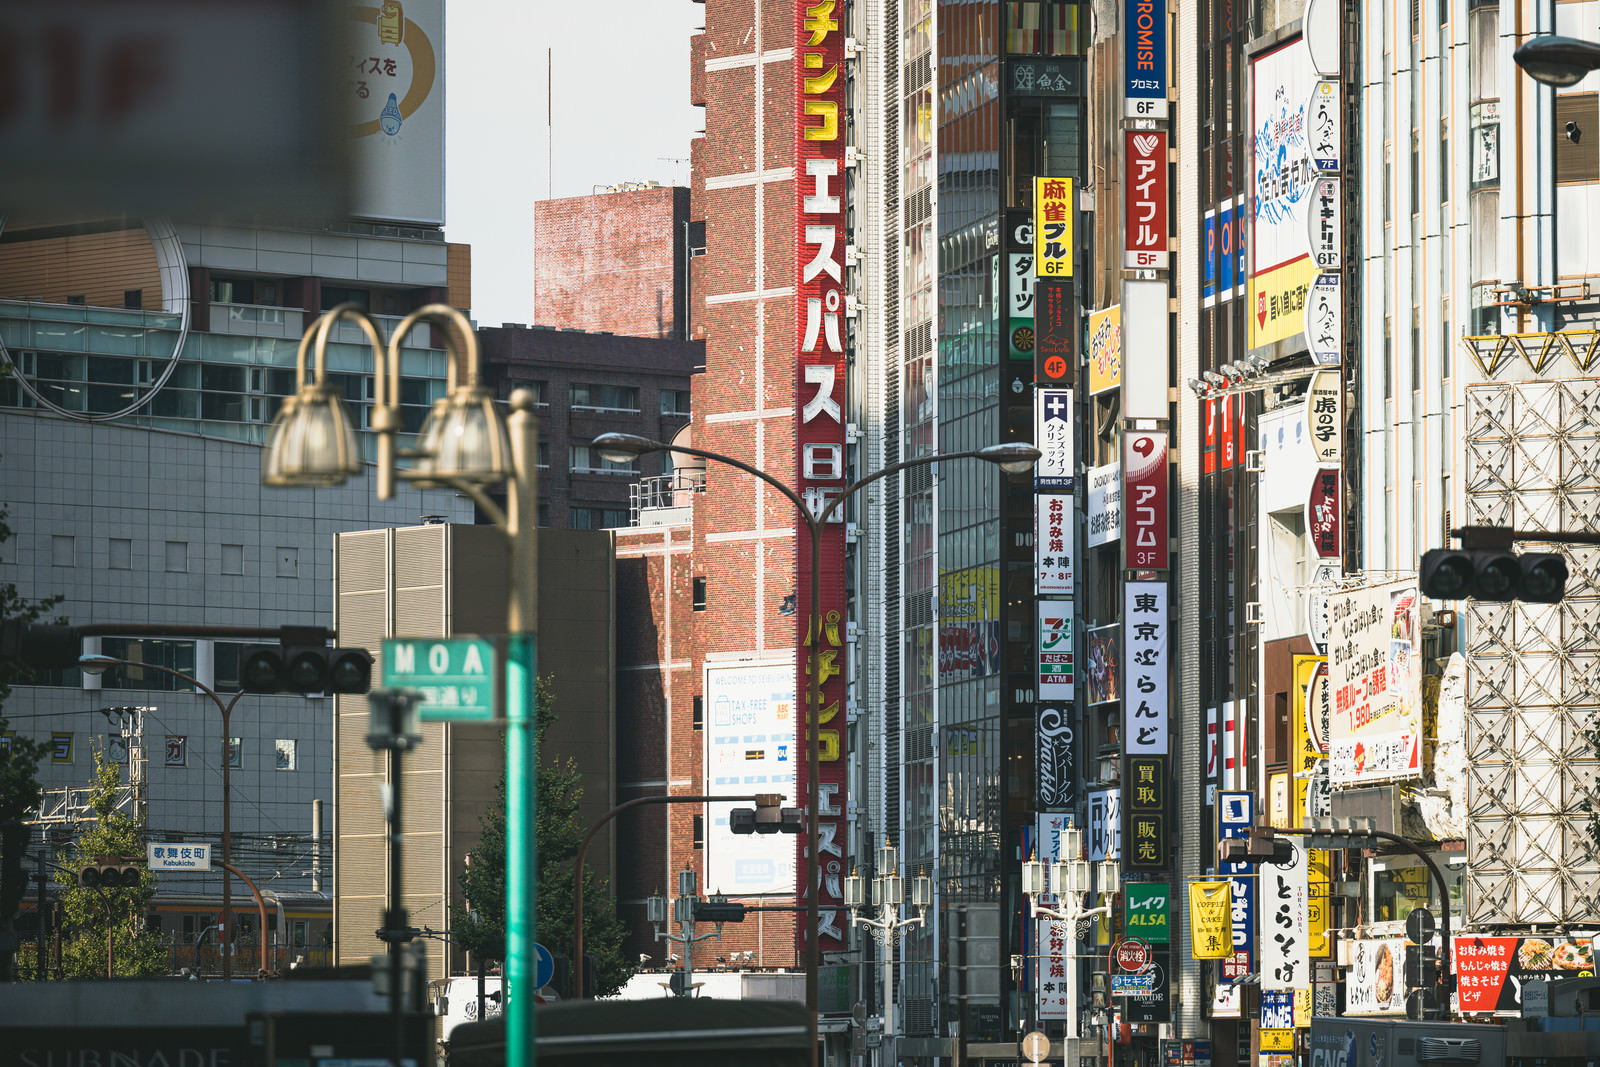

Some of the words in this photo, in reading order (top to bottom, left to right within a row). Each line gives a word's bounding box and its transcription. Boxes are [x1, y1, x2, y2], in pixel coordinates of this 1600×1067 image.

[355, 57, 397, 77] ィスを
[1130, 79, 1160, 90] プロミス
[1136, 101, 1155, 114] 6F
[1321, 161, 1335, 169] 7F
[1135, 159, 1158, 246] アイフル
[1042, 179, 1067, 259] 麻雀ブル
[1320, 195, 1335, 244] ヤキトリ
[1136, 253, 1157, 265] 5F
[1317, 252, 1338, 265] 6F
[1045, 261, 1065, 274] 6F
[1014, 256, 1034, 313] ダーツ
[1322, 353, 1336, 362] 5F
[1047, 360, 1063, 373] 4F
[1313, 396, 1337, 442] 虎の子
[1047, 423, 1055, 468] クリニック
[1056, 423, 1065, 476] メンズライフ
[1321, 448, 1337, 457] 4F
[1063, 478, 1073, 488] 3F
[1135, 485, 1157, 547] アコム
[1042, 556, 1070, 569] 本陣
[1136, 552, 1156, 564] 3F
[394, 643, 484, 674] MOA
[1044, 654, 1069, 663] たばこ
[1051, 664, 1062, 673] 酒
[1046, 674, 1067, 684] ATM
[732, 698, 768, 714] TAX-FREE
[732, 712, 757, 726] SHOPS
[1056, 744, 1073, 805] スパークル
[1137, 765, 1157, 804] 買取
[1136, 821, 1157, 861] 販売
[153, 847, 205, 859] 歌舞伎町
[1129, 896, 1166, 910] レイク
[1128, 914, 1166, 926] ALSA
[1274, 874, 1300, 983] とらそば
[1204, 935, 1221, 952] 集
[1119, 949, 1144, 962] 消火栓
[1458, 944, 1507, 957] お好み焼き
[1224, 964, 1248, 977] 買取
[1460, 960, 1509, 972] もんじゃ焼き
[1123, 976, 1153, 987] セキネ
[1460, 975, 1501, 987] 焼きそば
[1462, 991, 1482, 1003] ピザ
